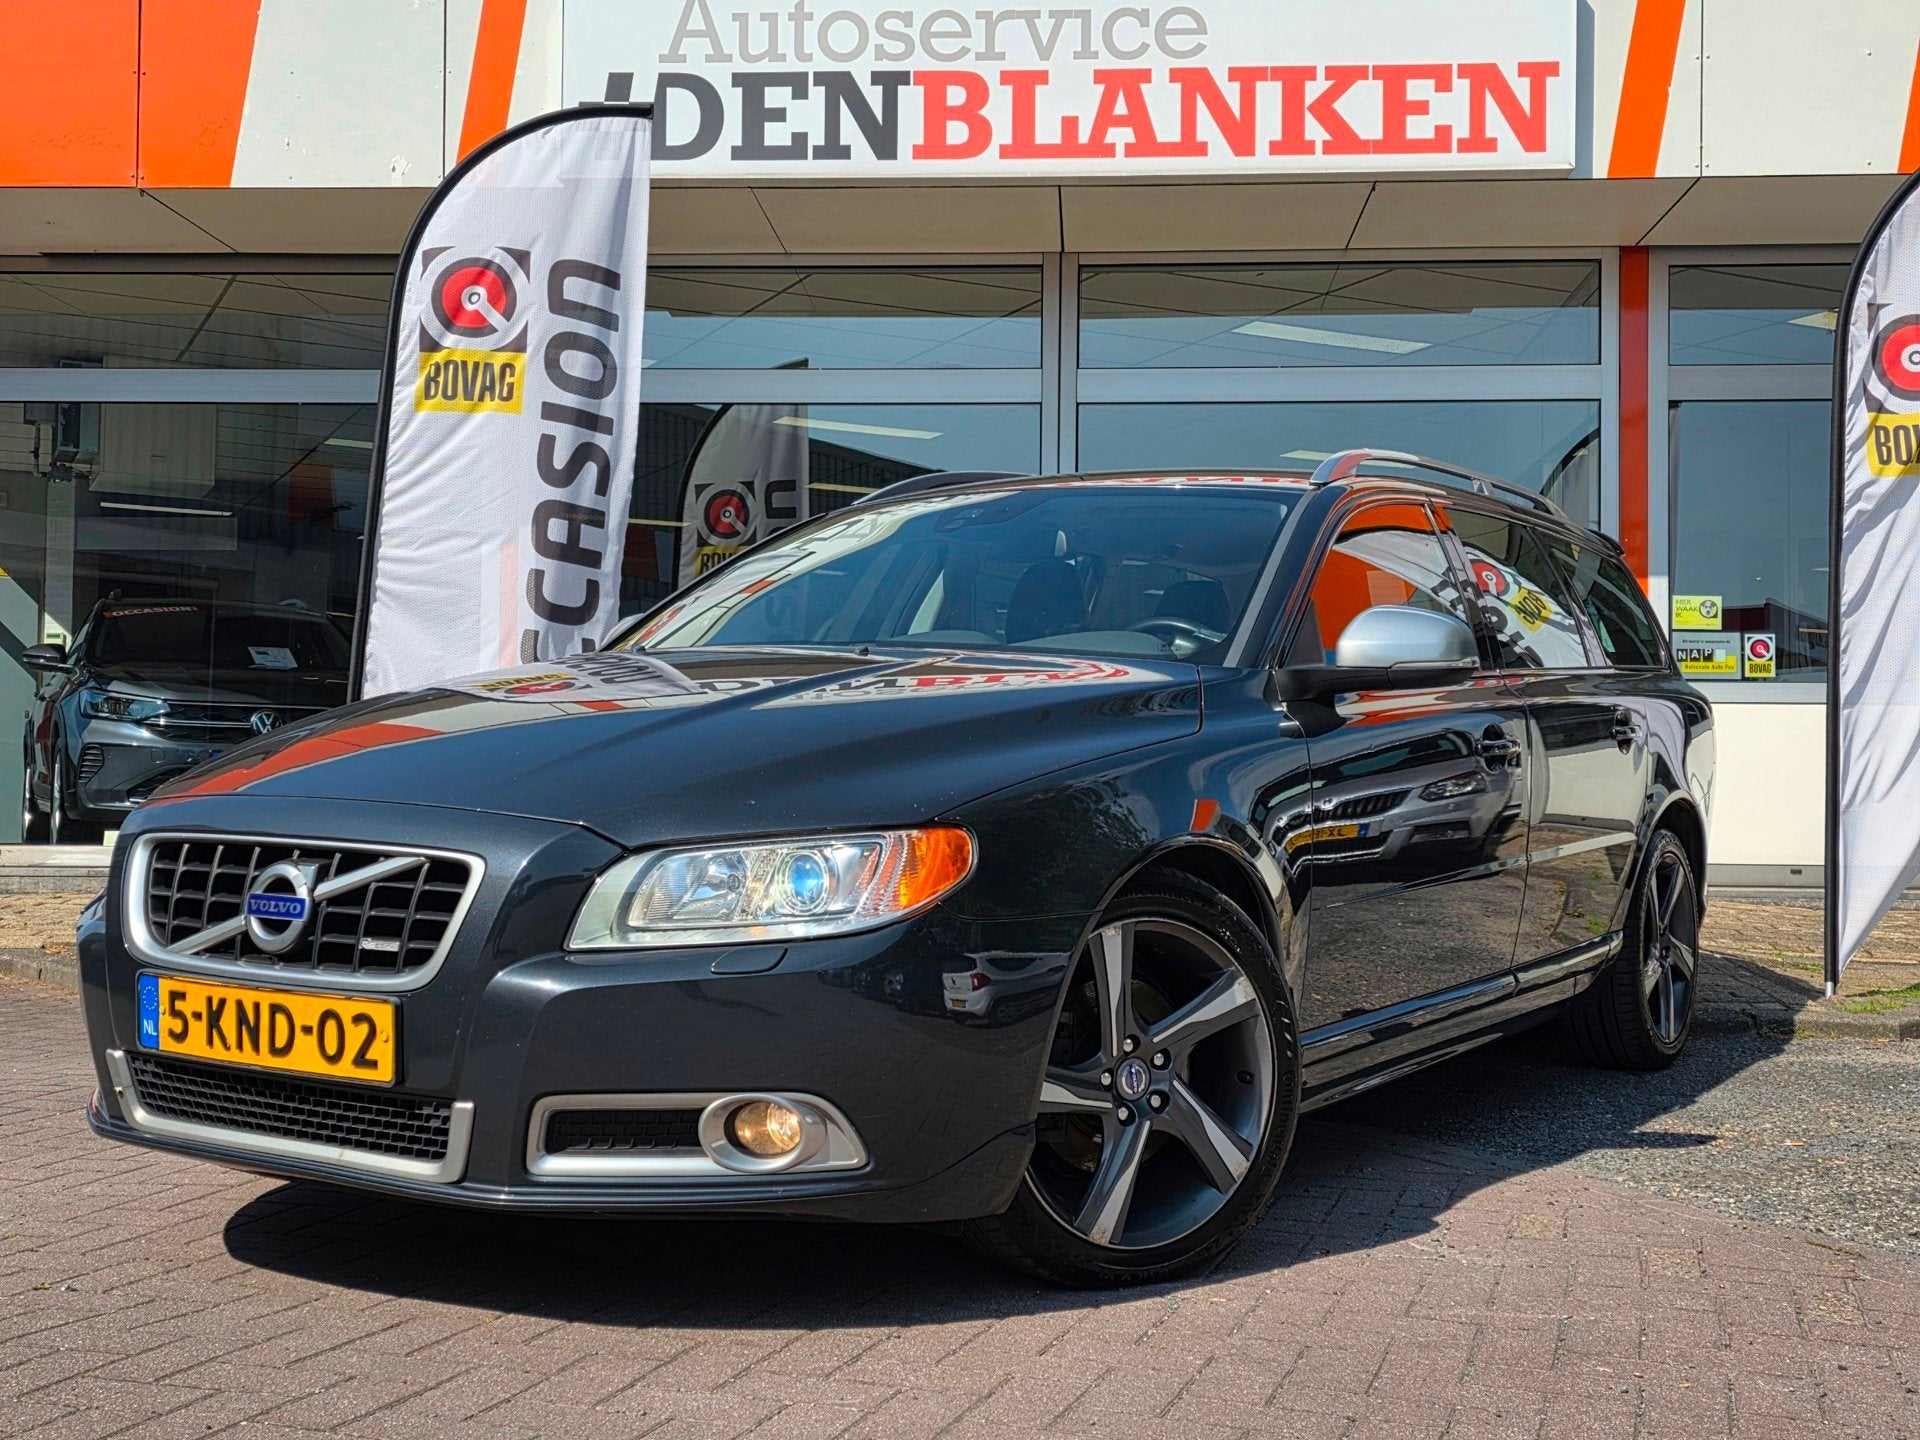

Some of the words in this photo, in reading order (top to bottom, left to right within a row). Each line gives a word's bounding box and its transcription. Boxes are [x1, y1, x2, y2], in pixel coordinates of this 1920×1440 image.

[658, 0, 1208, 63] Autoservice
[423, 361, 516, 402] BOVAG
[1677, 649, 1713, 661] NAP
[1749, 663, 1772, 674] BOVAG
[250, 899, 301, 914] VOLVO
[143, 1019, 158, 1035] NL
[168, 989, 379, 1071] 5-KND-02
